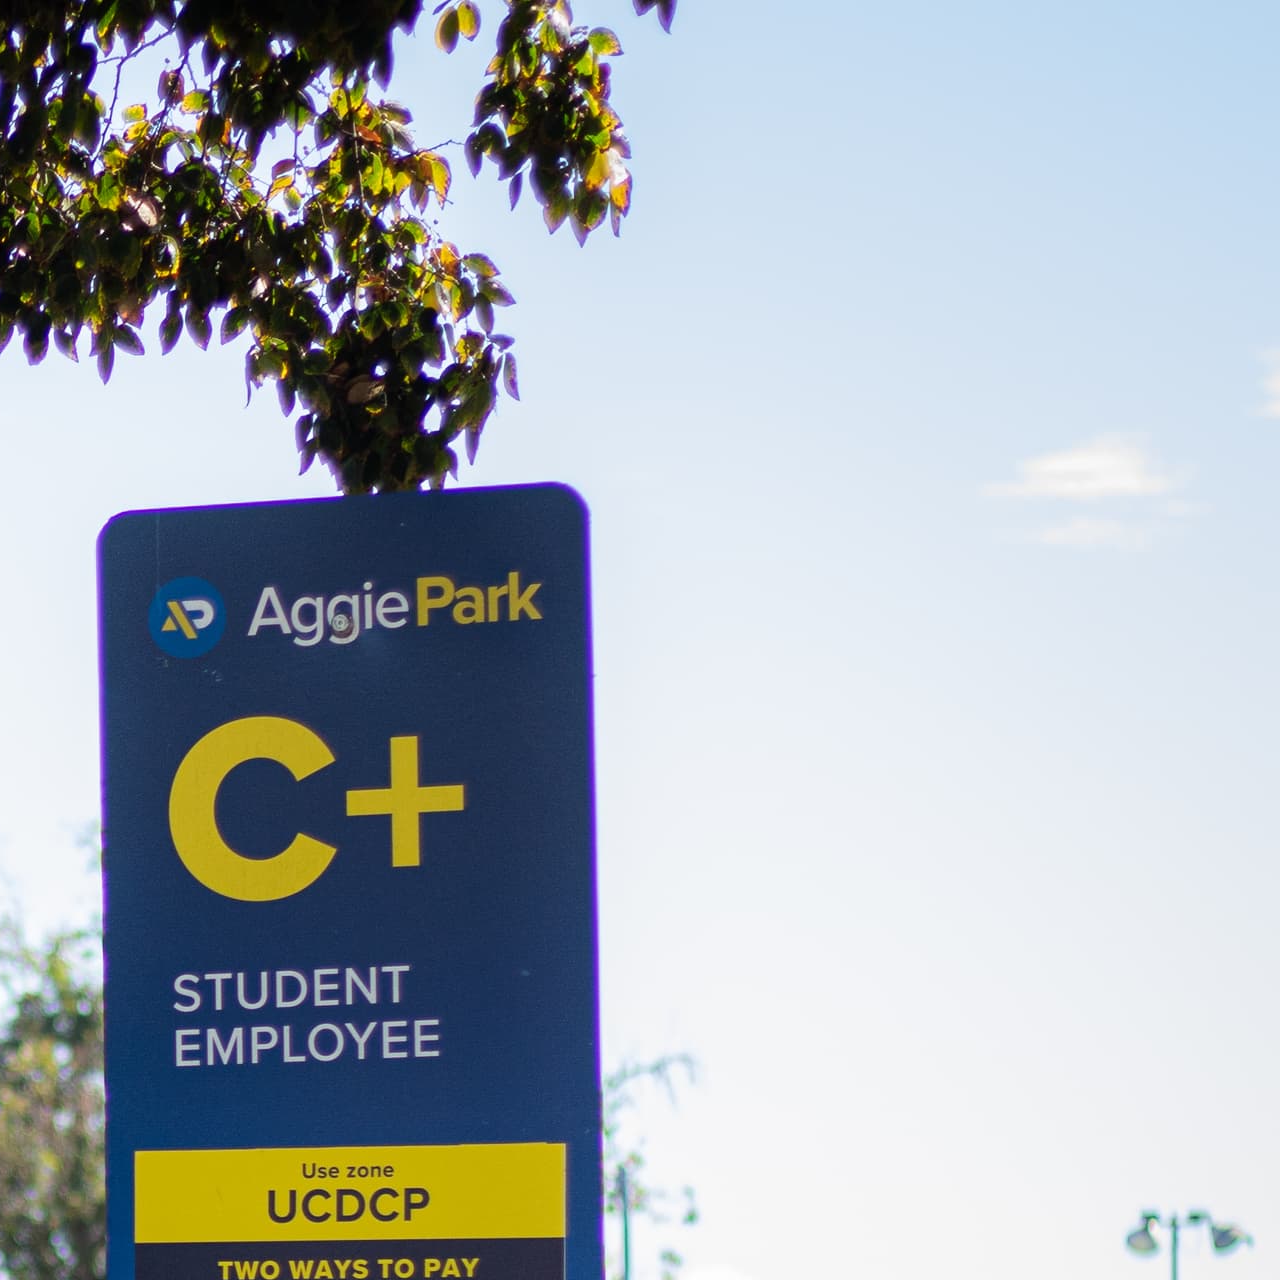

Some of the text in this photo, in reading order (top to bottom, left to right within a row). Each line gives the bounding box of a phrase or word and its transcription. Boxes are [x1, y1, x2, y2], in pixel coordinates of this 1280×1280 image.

[169, 717, 464, 901] C+
[173, 966, 410, 1012] STUDENT
[175, 1020, 440, 1066] EMPLOYEE
[302, 1163, 394, 1179] Use zone
[267, 1188, 430, 1223] UCDCP
[218, 1258, 479, 1280] TWO WAYS TO PAY
